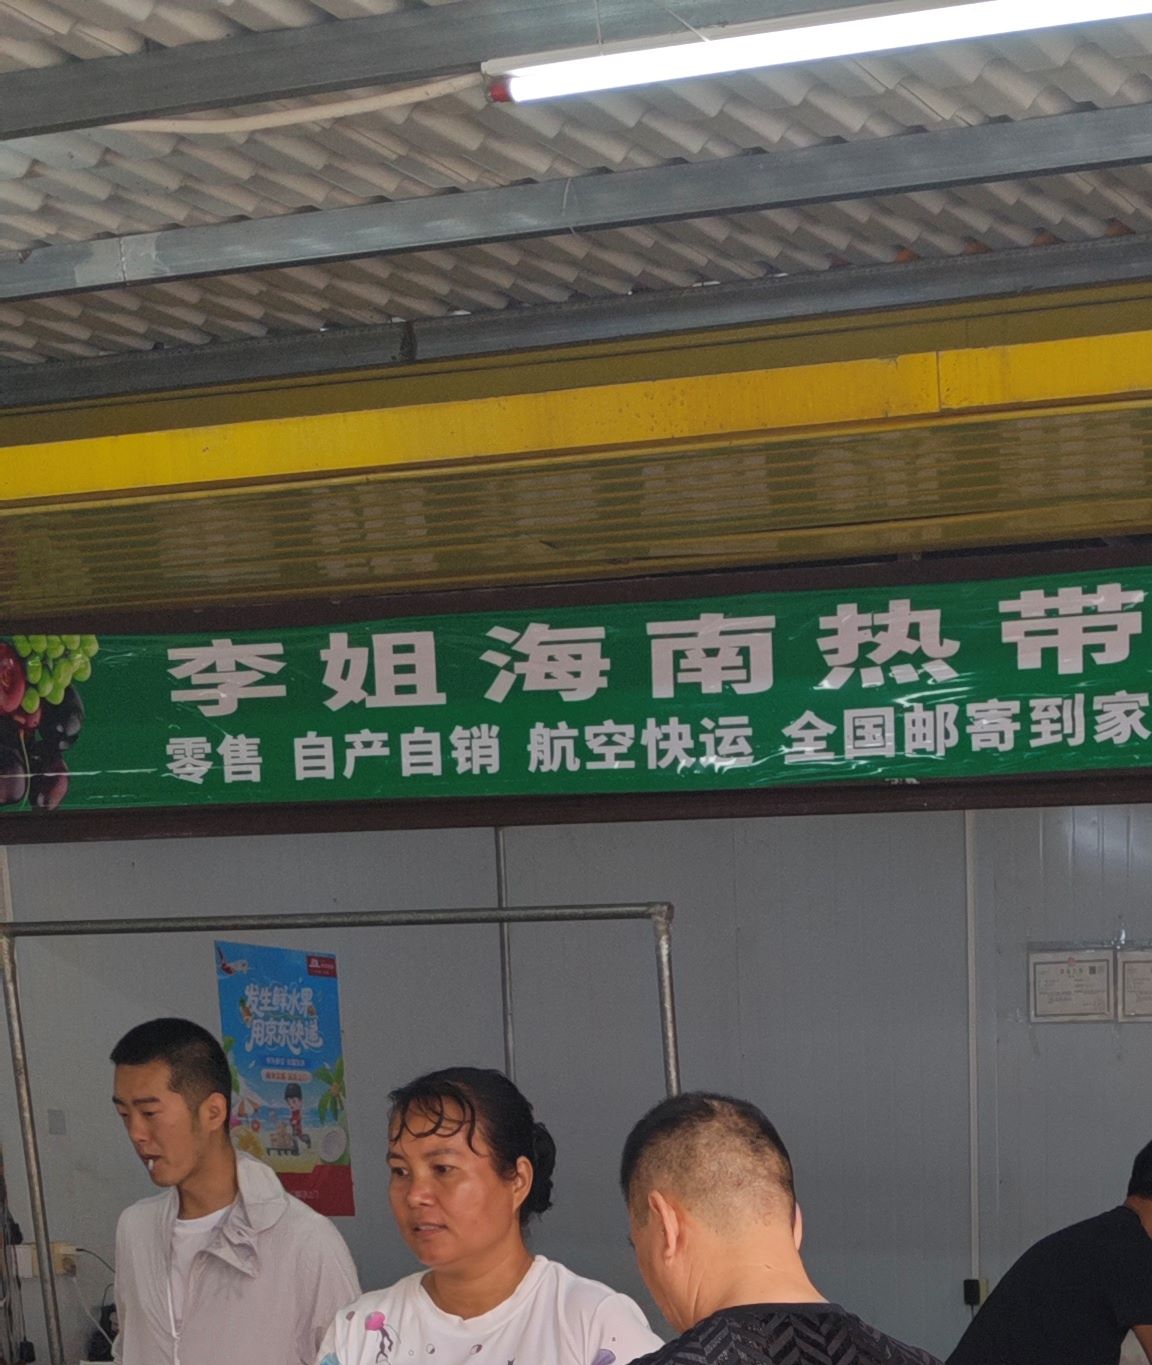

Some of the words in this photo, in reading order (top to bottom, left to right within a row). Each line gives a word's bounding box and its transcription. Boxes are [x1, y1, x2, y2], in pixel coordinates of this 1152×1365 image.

[166, 733, 263, 784] 零售
[293, 723, 500, 781] 自产自销
[527, 716, 755, 773] 航空快运
[781, 690, 1152, 765] 全国邮寄到家
